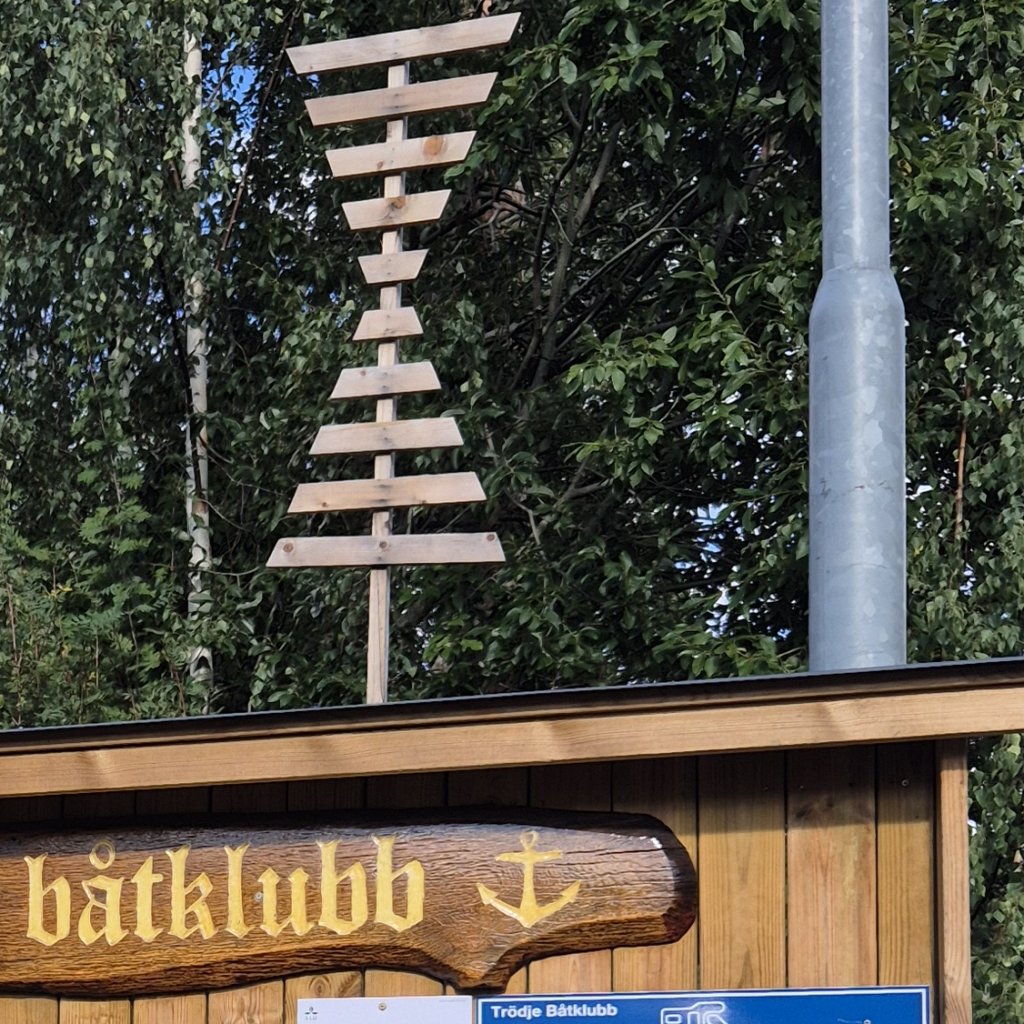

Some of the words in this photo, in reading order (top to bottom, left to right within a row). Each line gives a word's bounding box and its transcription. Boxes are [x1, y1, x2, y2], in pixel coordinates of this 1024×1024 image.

[25, 835, 426, 946] båtklubb
[491, 1003, 542, 1019] Trödje
[546, 1002, 618, 1017] Båtklubb
